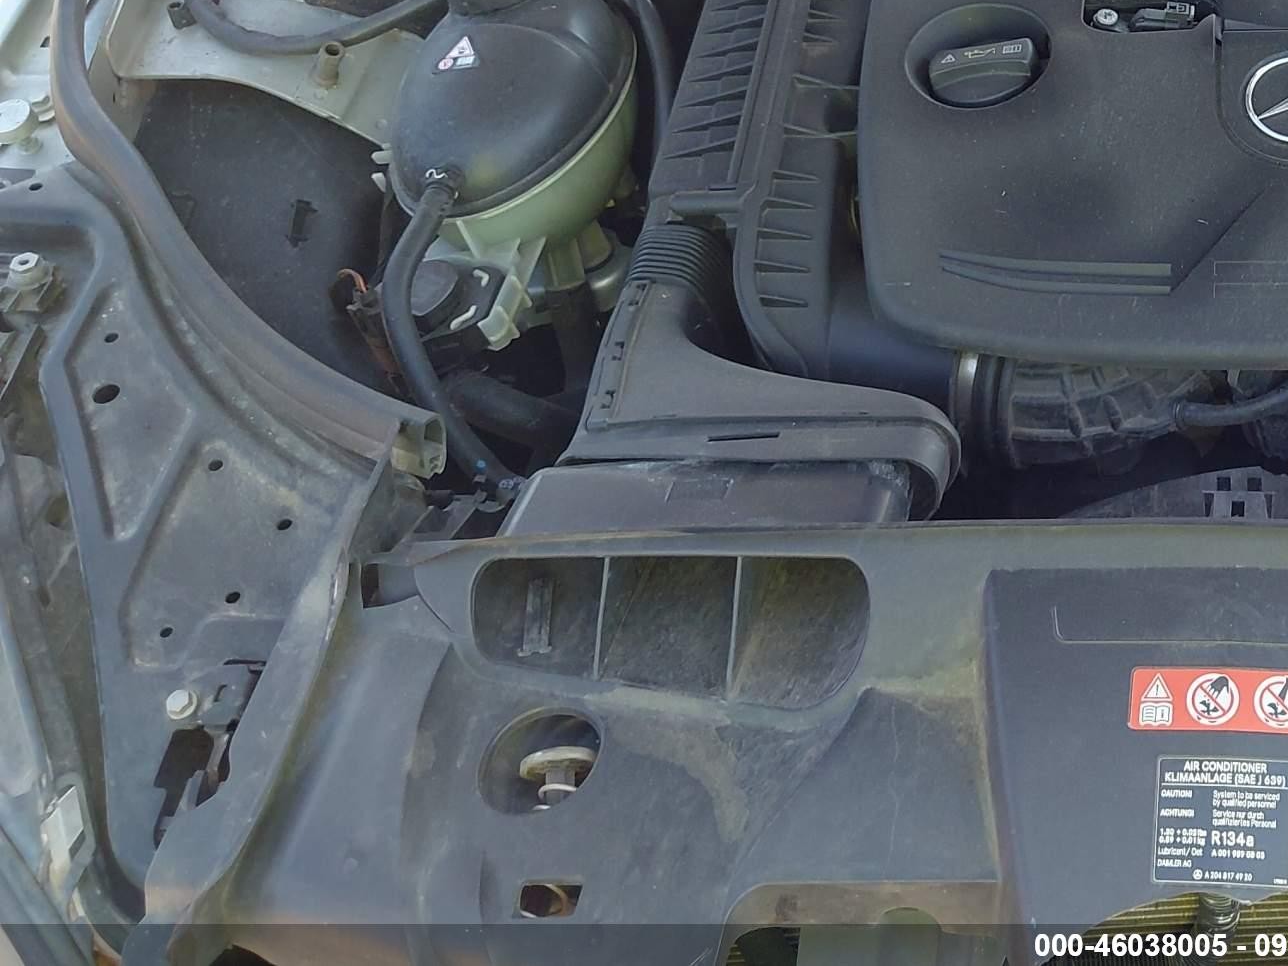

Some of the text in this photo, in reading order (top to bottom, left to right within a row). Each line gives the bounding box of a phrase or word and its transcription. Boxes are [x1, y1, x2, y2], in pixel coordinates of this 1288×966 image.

[1184, 761, 1268, 774] AIR CONDITIONER
[1165, 772, 1233, 784] KLIMAANLAGE
[1235, 774, 1256, 786] (SAE
[1264, 775, 1286, 786] 639)
[1213, 789, 1280, 801] System to be serviced
[1213, 798, 1277, 809] by qualified personnel
[1160, 809, 1194, 818] ACHTUNG!
[1213, 809, 1264, 820] Service nur durch
[1251, 819, 1277, 829] Personal
[1211, 831, 1255, 847] R134a
[1218, 848, 1231, 858] 001
[1182, 859, 1192, 867] AG
